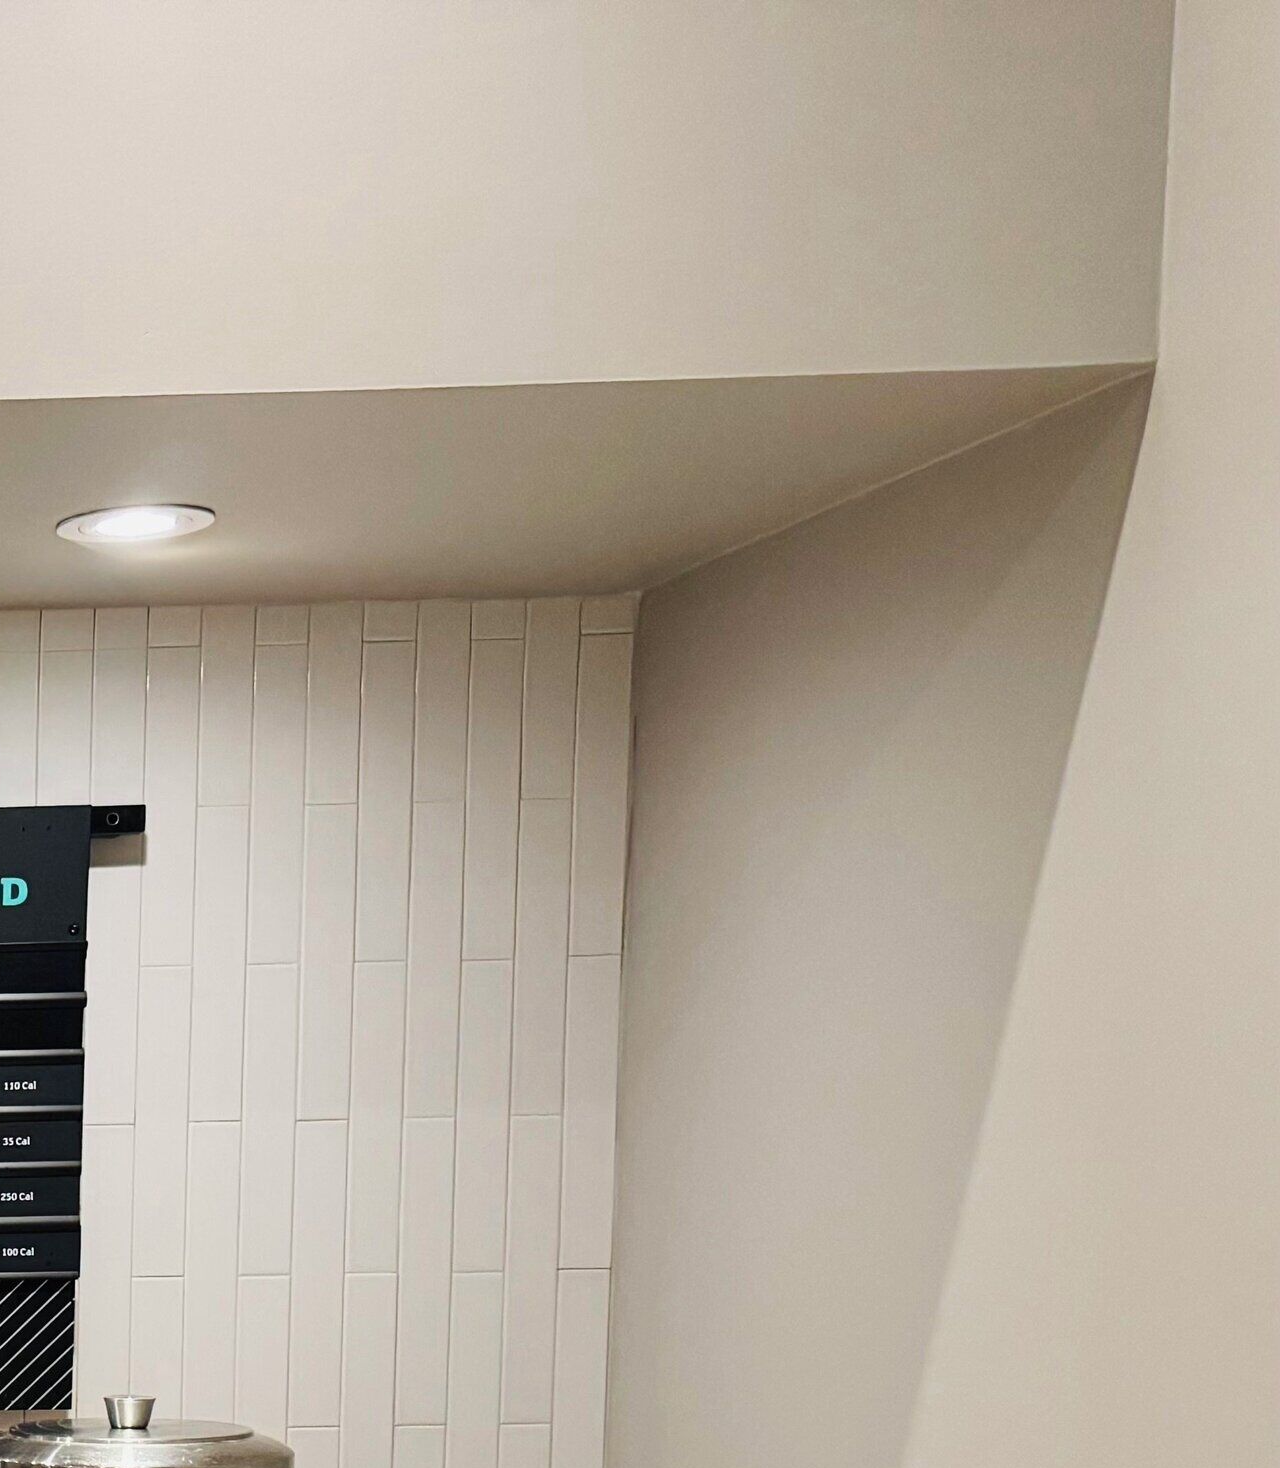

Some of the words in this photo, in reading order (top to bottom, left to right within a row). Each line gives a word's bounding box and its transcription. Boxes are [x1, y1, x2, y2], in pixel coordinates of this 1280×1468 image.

[4, 1081, 21, 1091] 110
[22, 1080, 37, 1090] Cal
[2, 1137, 14, 1146] 35
[15, 1136, 31, 1146] Cal
[0, 1193, 18, 1201] 250
[18, 1192, 34, 1201] Cal
[2, 1248, 19, 1257] 100
[20, 1247, 35, 1257] Cal
